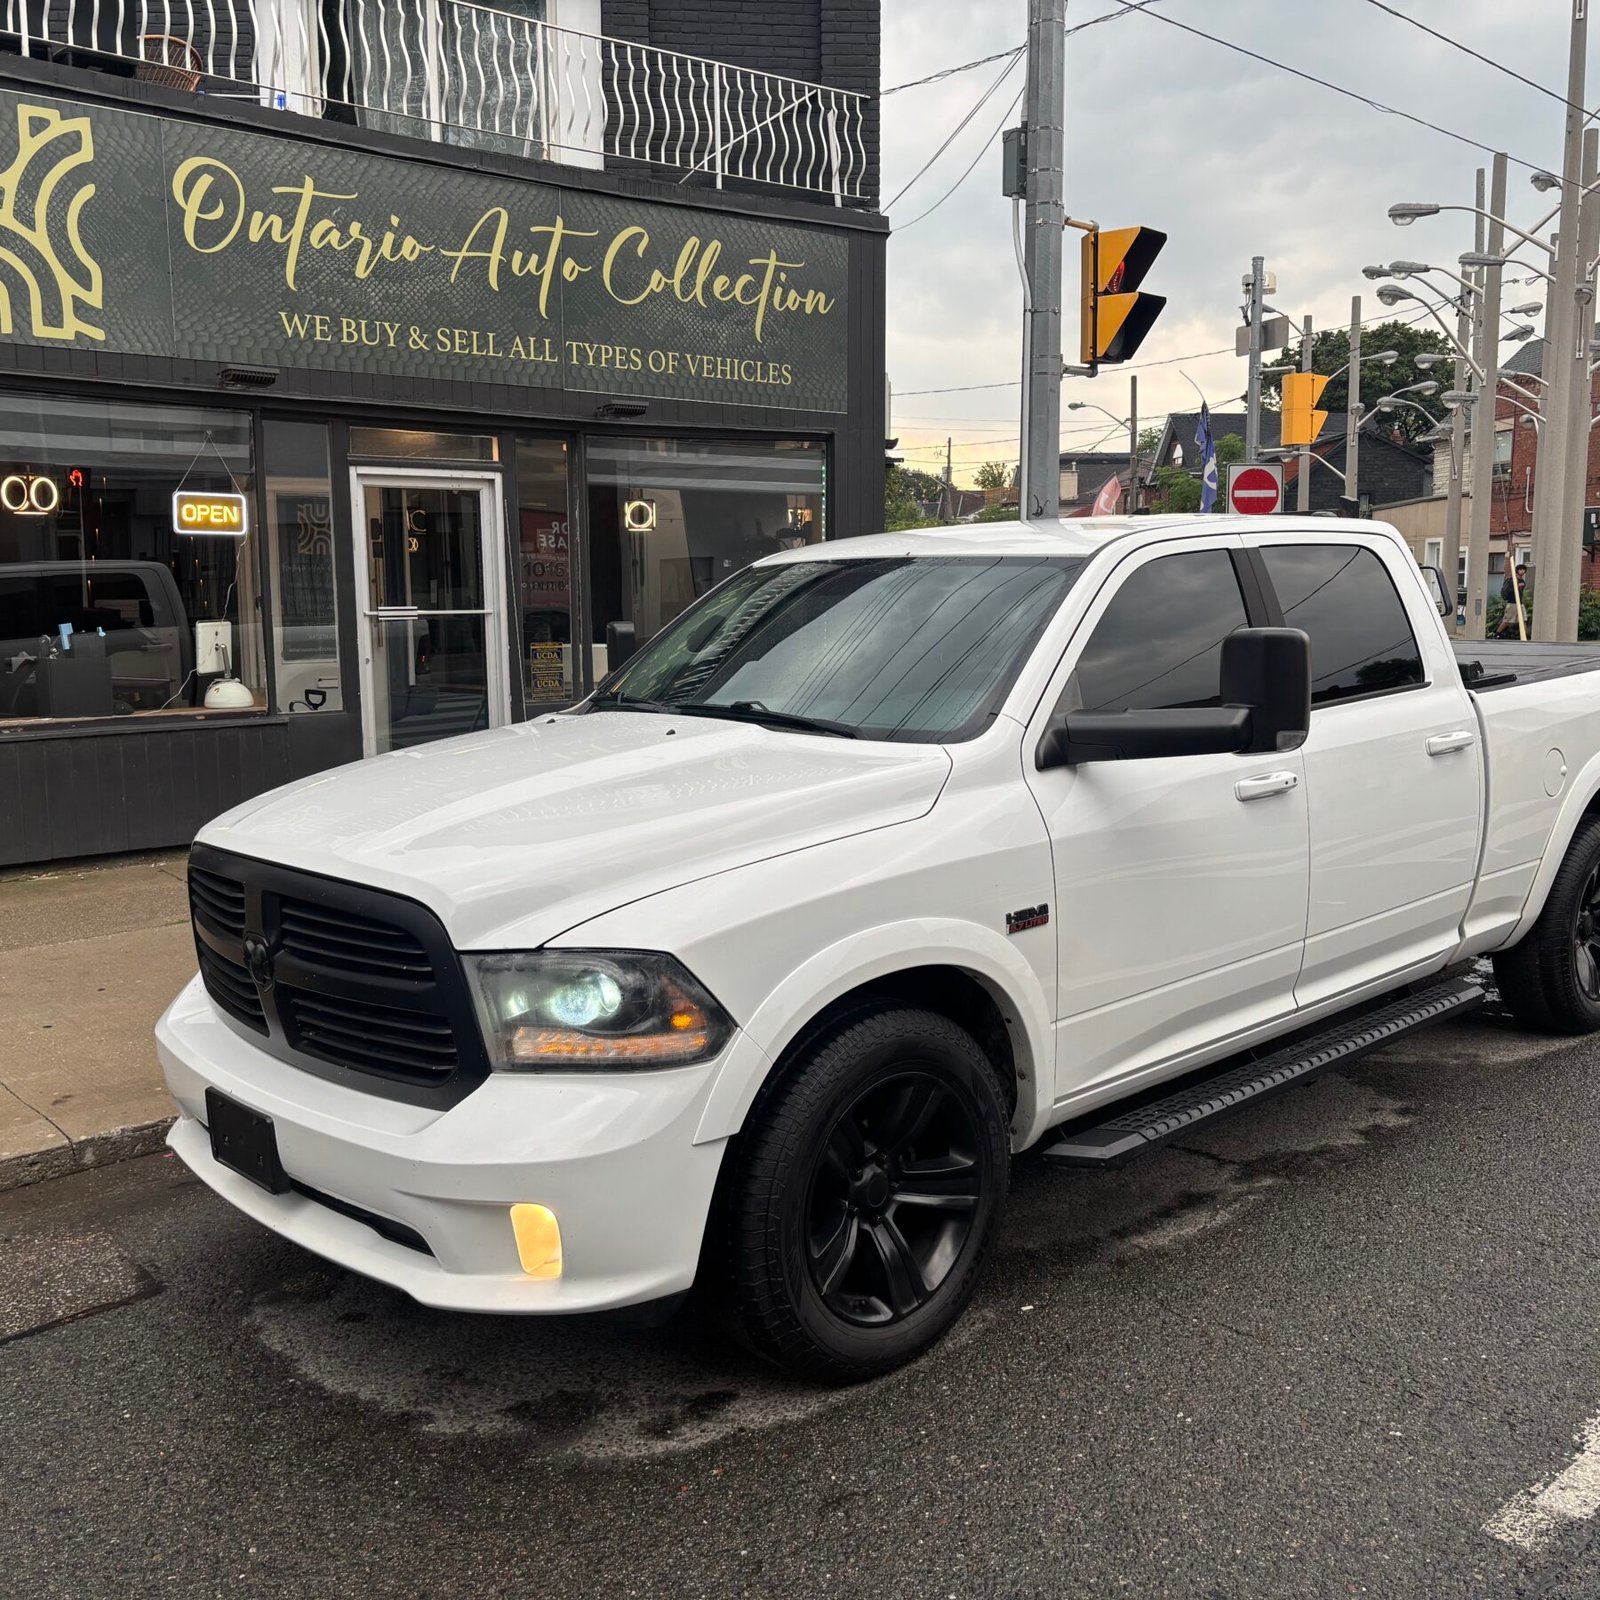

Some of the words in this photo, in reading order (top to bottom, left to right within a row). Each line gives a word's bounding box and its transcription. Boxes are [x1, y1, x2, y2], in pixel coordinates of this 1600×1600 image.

[172, 157, 434, 291] Ontario
[440, 206, 599, 320] Auto
[603, 226, 835, 343] Collection
[278, 311, 332, 342] WE
[340, 319, 401, 348] BUY
[408, 326, 430, 350] &
[436, 327, 502, 357] SELL
[510, 335, 558, 363] ALL
[565, 340, 642, 371] TYPES
[648, 350, 680, 375] OF
[684, 354, 793, 386] VEHICLES
[181, 503, 240, 523] OPEN
[536, 651, 559, 660] UCDA
[537, 680, 560, 688] UCDA
